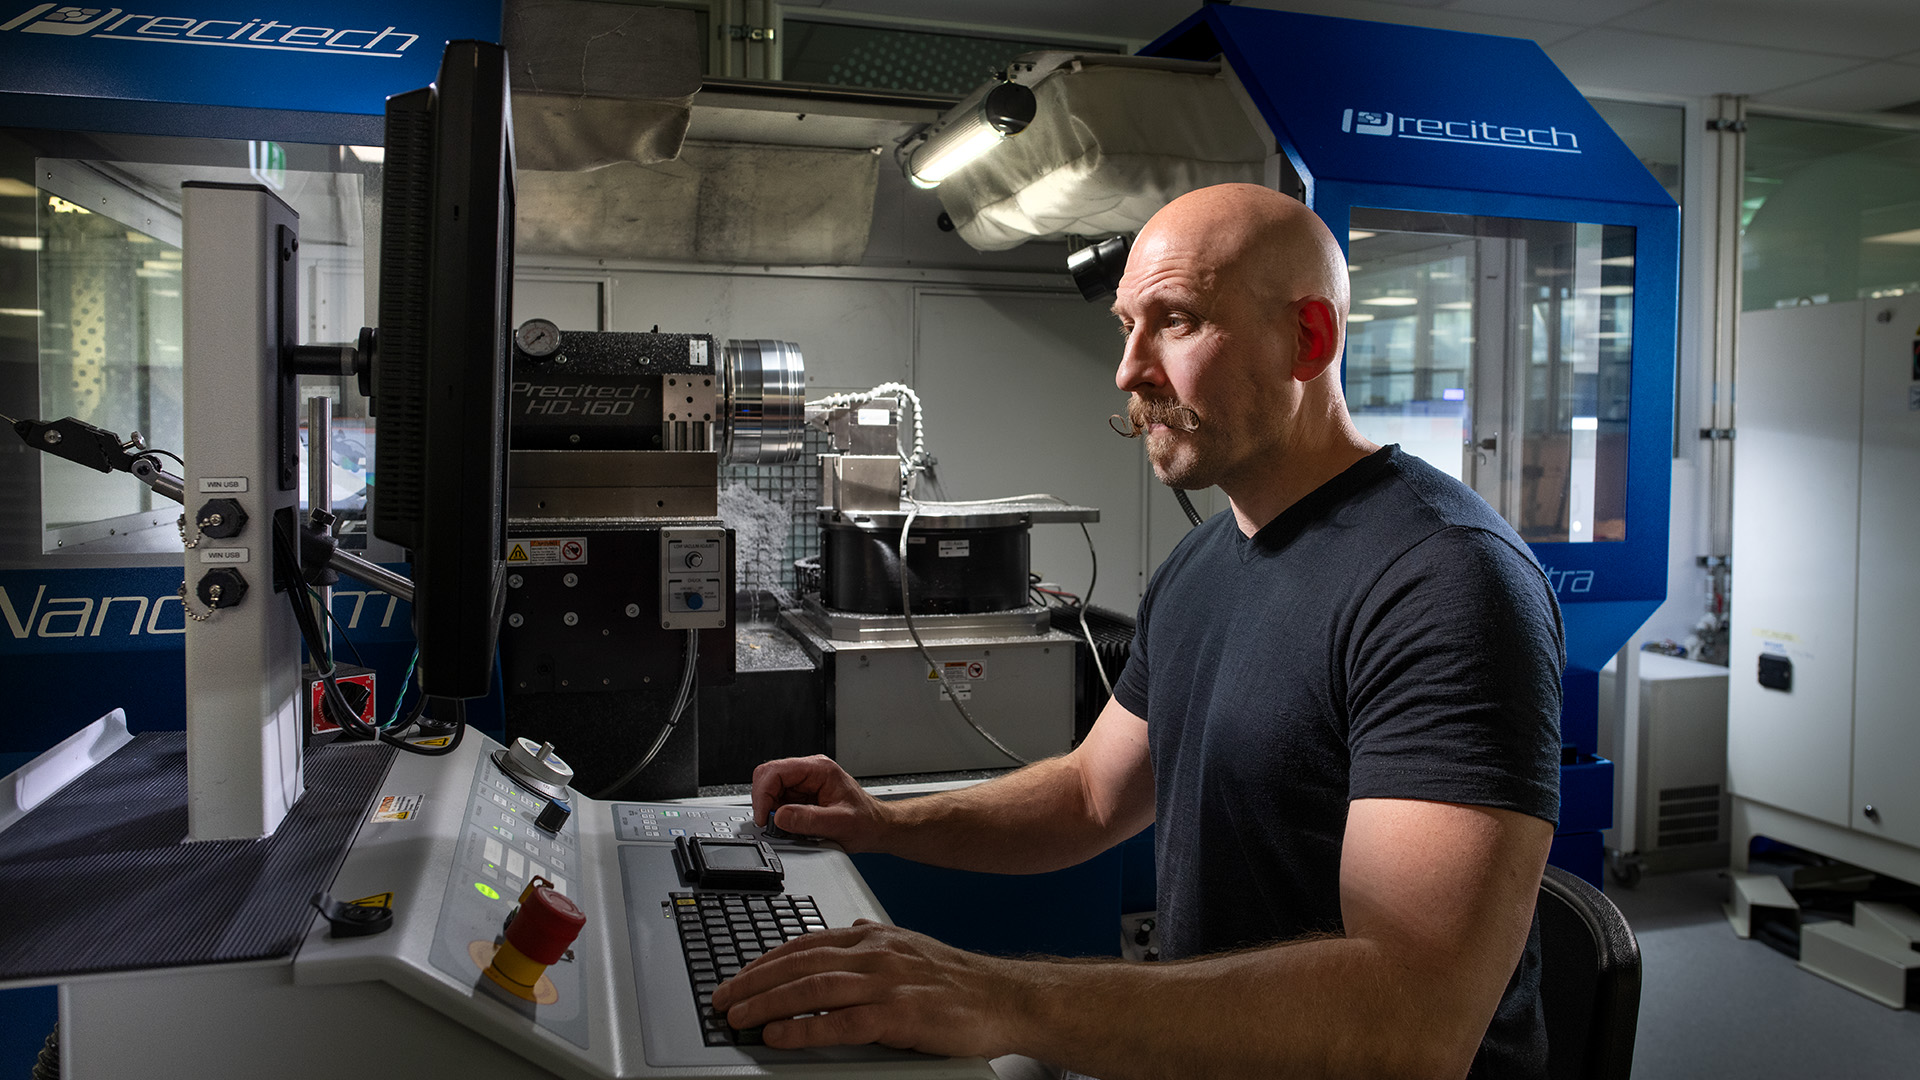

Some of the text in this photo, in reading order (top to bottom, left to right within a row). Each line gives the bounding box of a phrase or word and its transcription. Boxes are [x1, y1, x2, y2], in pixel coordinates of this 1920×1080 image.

[1341, 108, 1579, 149] Precitech
[512, 382, 651, 399] Precitech
[525, 400, 635, 416] HD-160
[1541, 564, 1595, 594] tra
